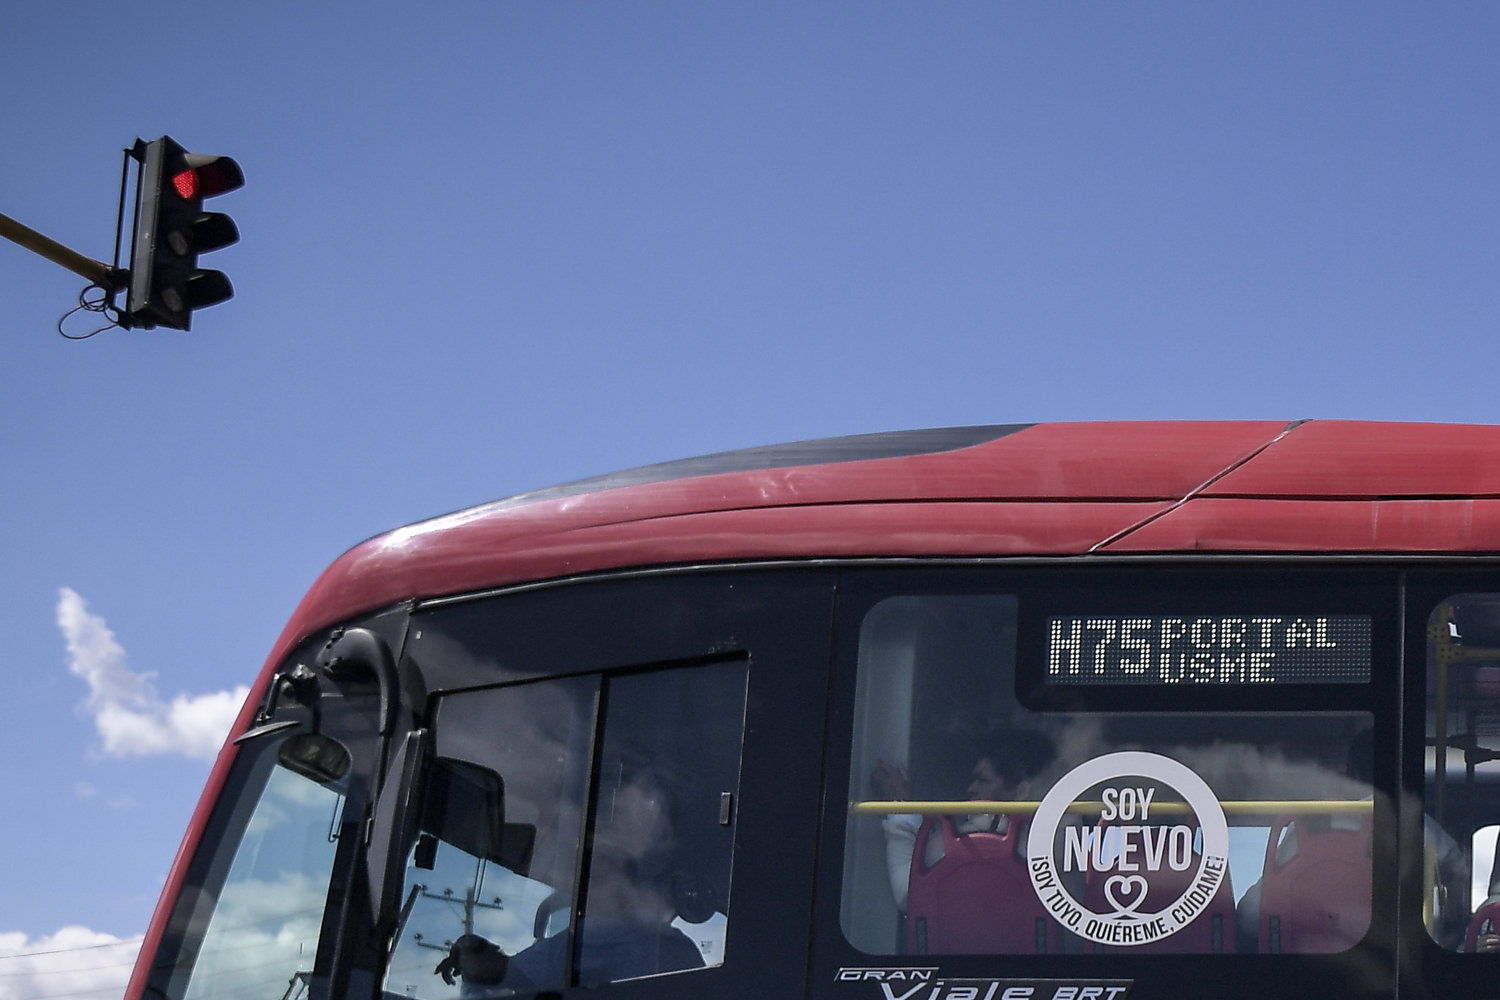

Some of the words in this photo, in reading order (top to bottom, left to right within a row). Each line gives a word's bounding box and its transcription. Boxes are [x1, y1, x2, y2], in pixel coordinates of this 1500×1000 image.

[1049, 618, 1151, 675] H75
[1159, 617, 1337, 649] PORTAL
[1159, 652, 1277, 684] USME
[1101, 788, 1155, 821] SOY
[1063, 824, 1193, 872] NUEVO
[1046, 889, 1083, 932] TUYO,
[1085, 918, 1175, 943] QUIÉREME,
[1171, 855, 1225, 925] CUÍDAME!
[839, 970, 932, 981] GRAN
